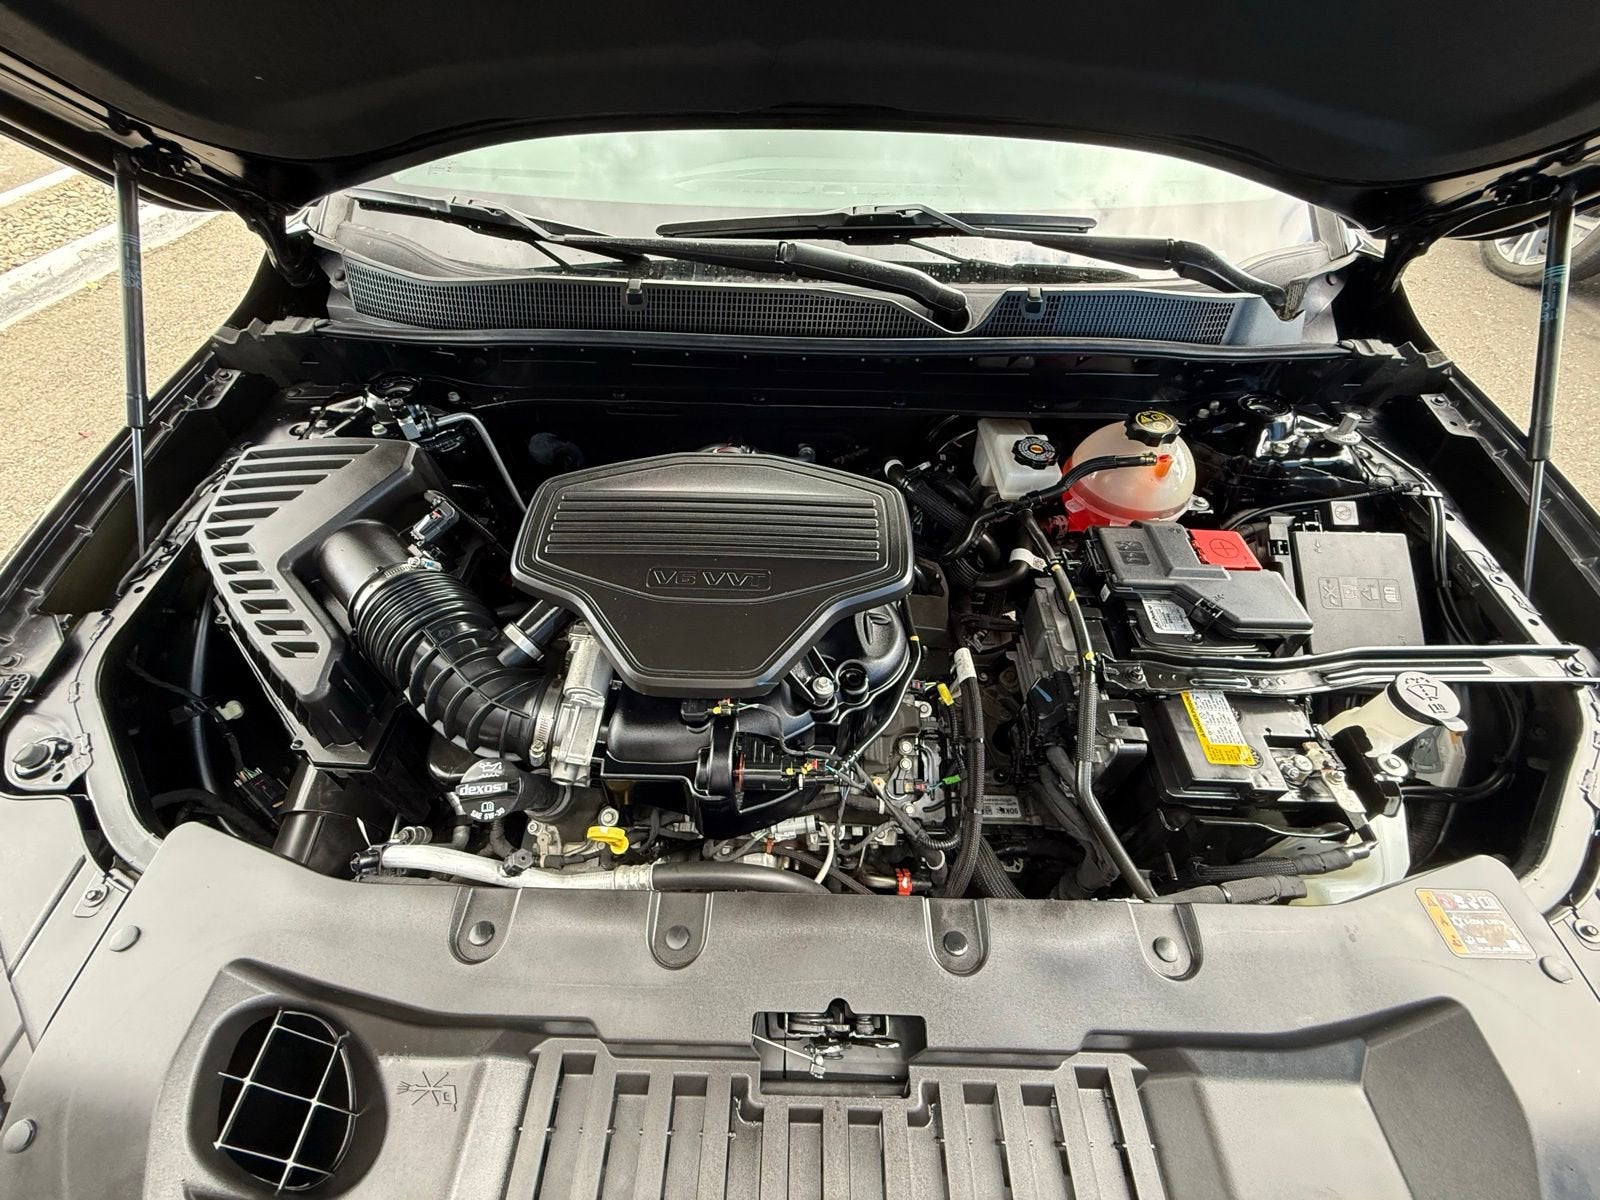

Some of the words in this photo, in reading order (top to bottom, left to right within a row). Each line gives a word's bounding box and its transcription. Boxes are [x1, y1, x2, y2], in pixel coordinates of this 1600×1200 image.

[653, 570, 696, 585] V6
[702, 571, 767, 587] VVT
[460, 783, 501, 796] dexos
[470, 809, 483, 820] SAE
